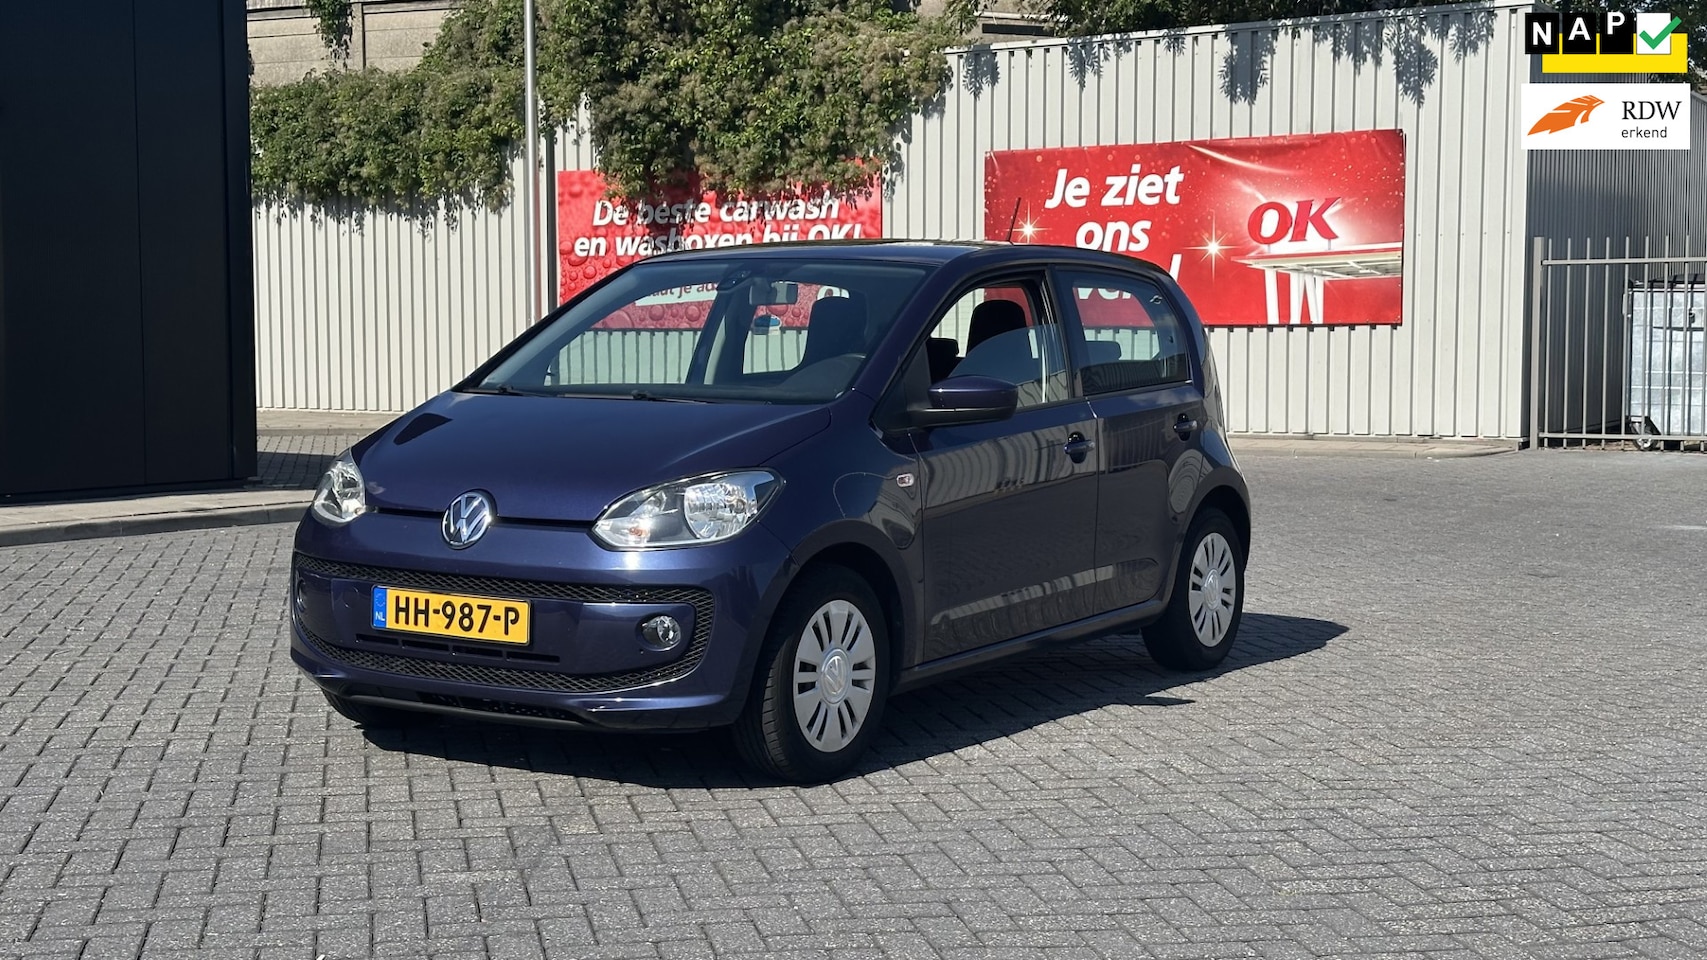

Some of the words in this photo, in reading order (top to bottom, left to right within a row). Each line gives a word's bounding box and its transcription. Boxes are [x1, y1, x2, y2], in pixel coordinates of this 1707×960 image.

[1044, 168, 1091, 209] Je
[1101, 163, 1184, 206] ziet
[593, 199, 629, 226] De
[636, 198, 711, 225] beste
[719, 191, 840, 223] carwash
[1247, 197, 1341, 245] OK
[574, 236, 607, 257] en
[1076, 220, 1152, 252] ons
[375, 611, 386, 621] NL
[394, 595, 520, 636] HH-987-P
